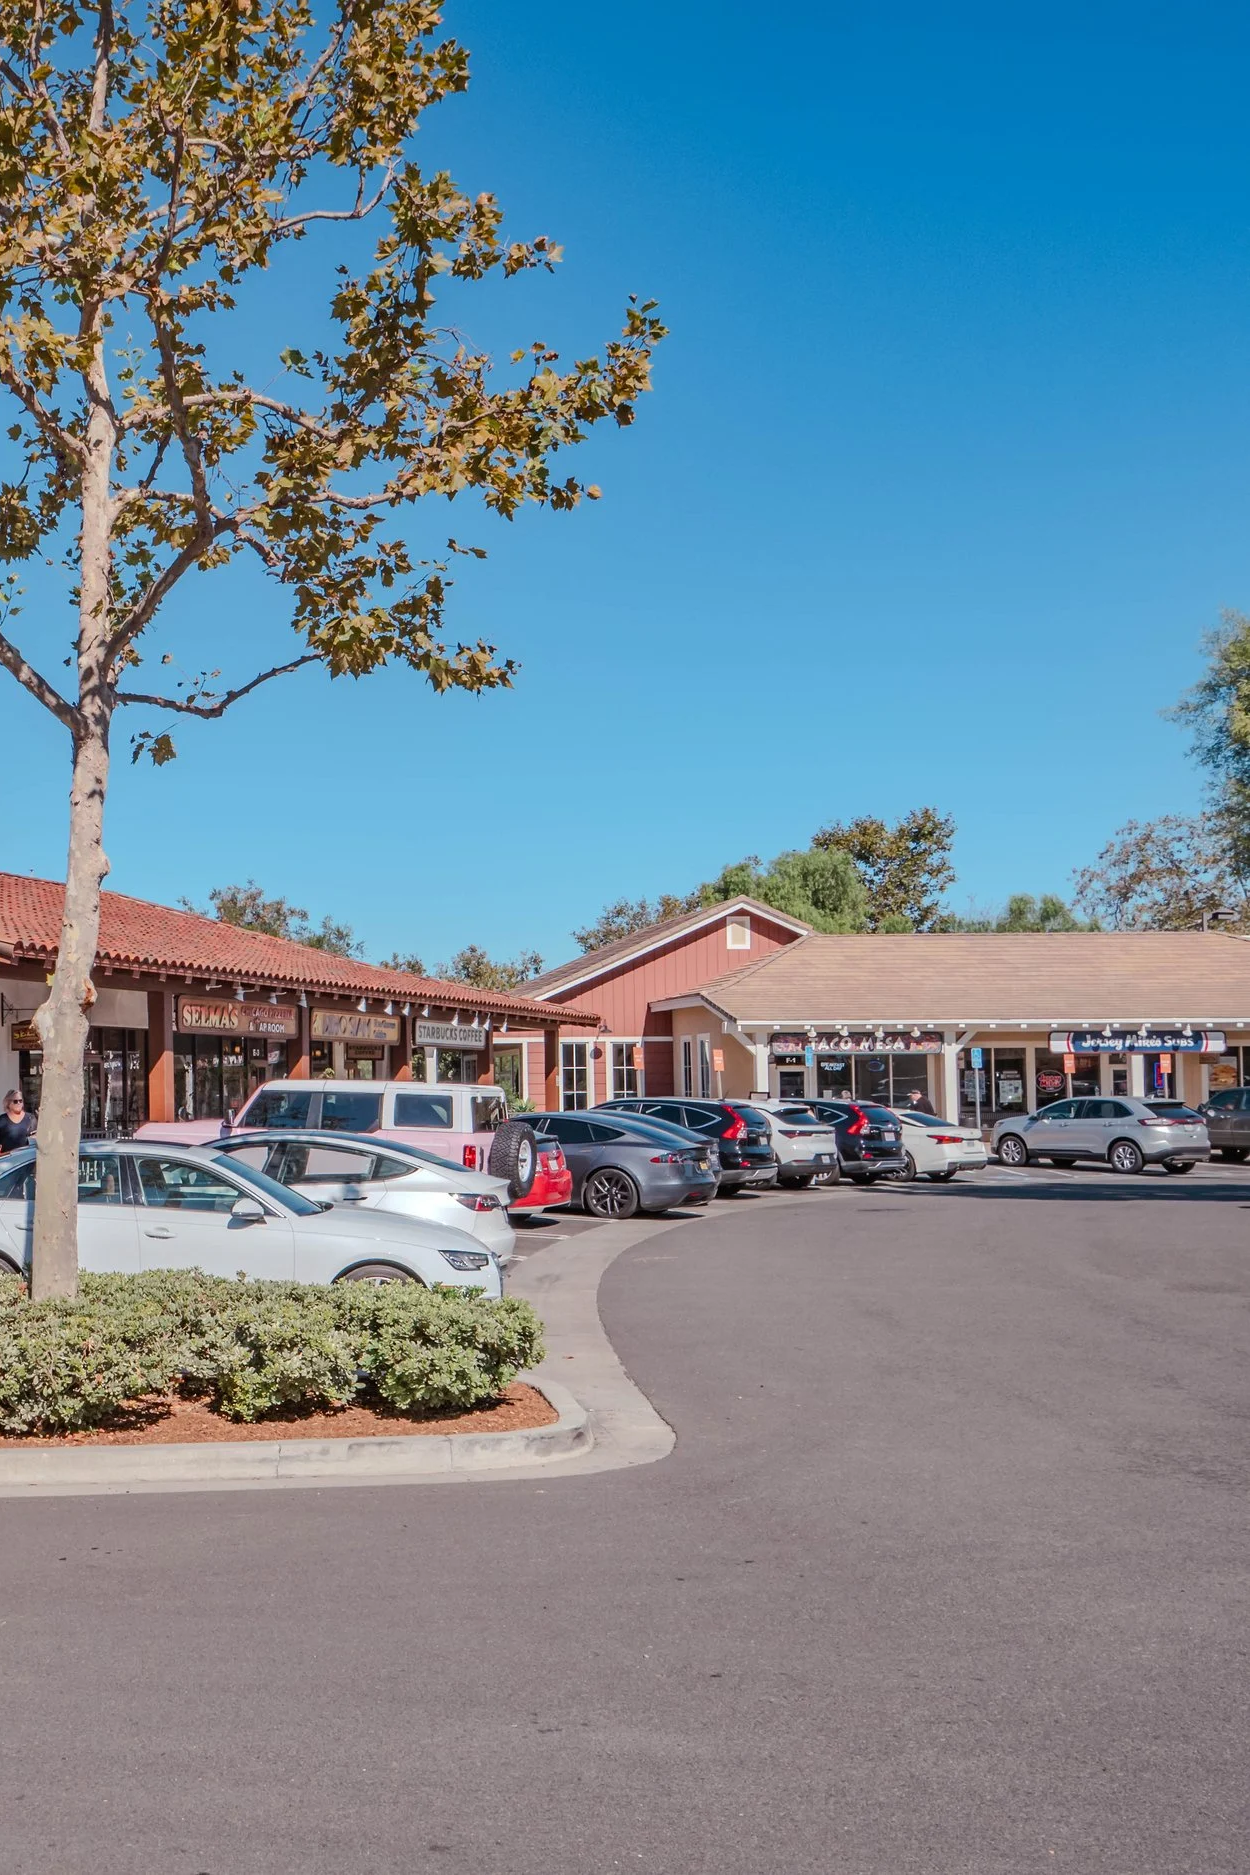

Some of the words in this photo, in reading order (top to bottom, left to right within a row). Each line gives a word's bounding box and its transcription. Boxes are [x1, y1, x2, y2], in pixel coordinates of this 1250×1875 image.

[183, 1003, 239, 1030] SELMA'S
[418, 1025, 458, 1041] STARBUCKS
[459, 1028, 483, 1042] COFFEE
[808, 1037, 850, 1050] TACO
[859, 1037, 905, 1051] MESA
[1082, 1034, 1123, 1050] Jersey
[1125, 1034, 1162, 1048] Mike's
